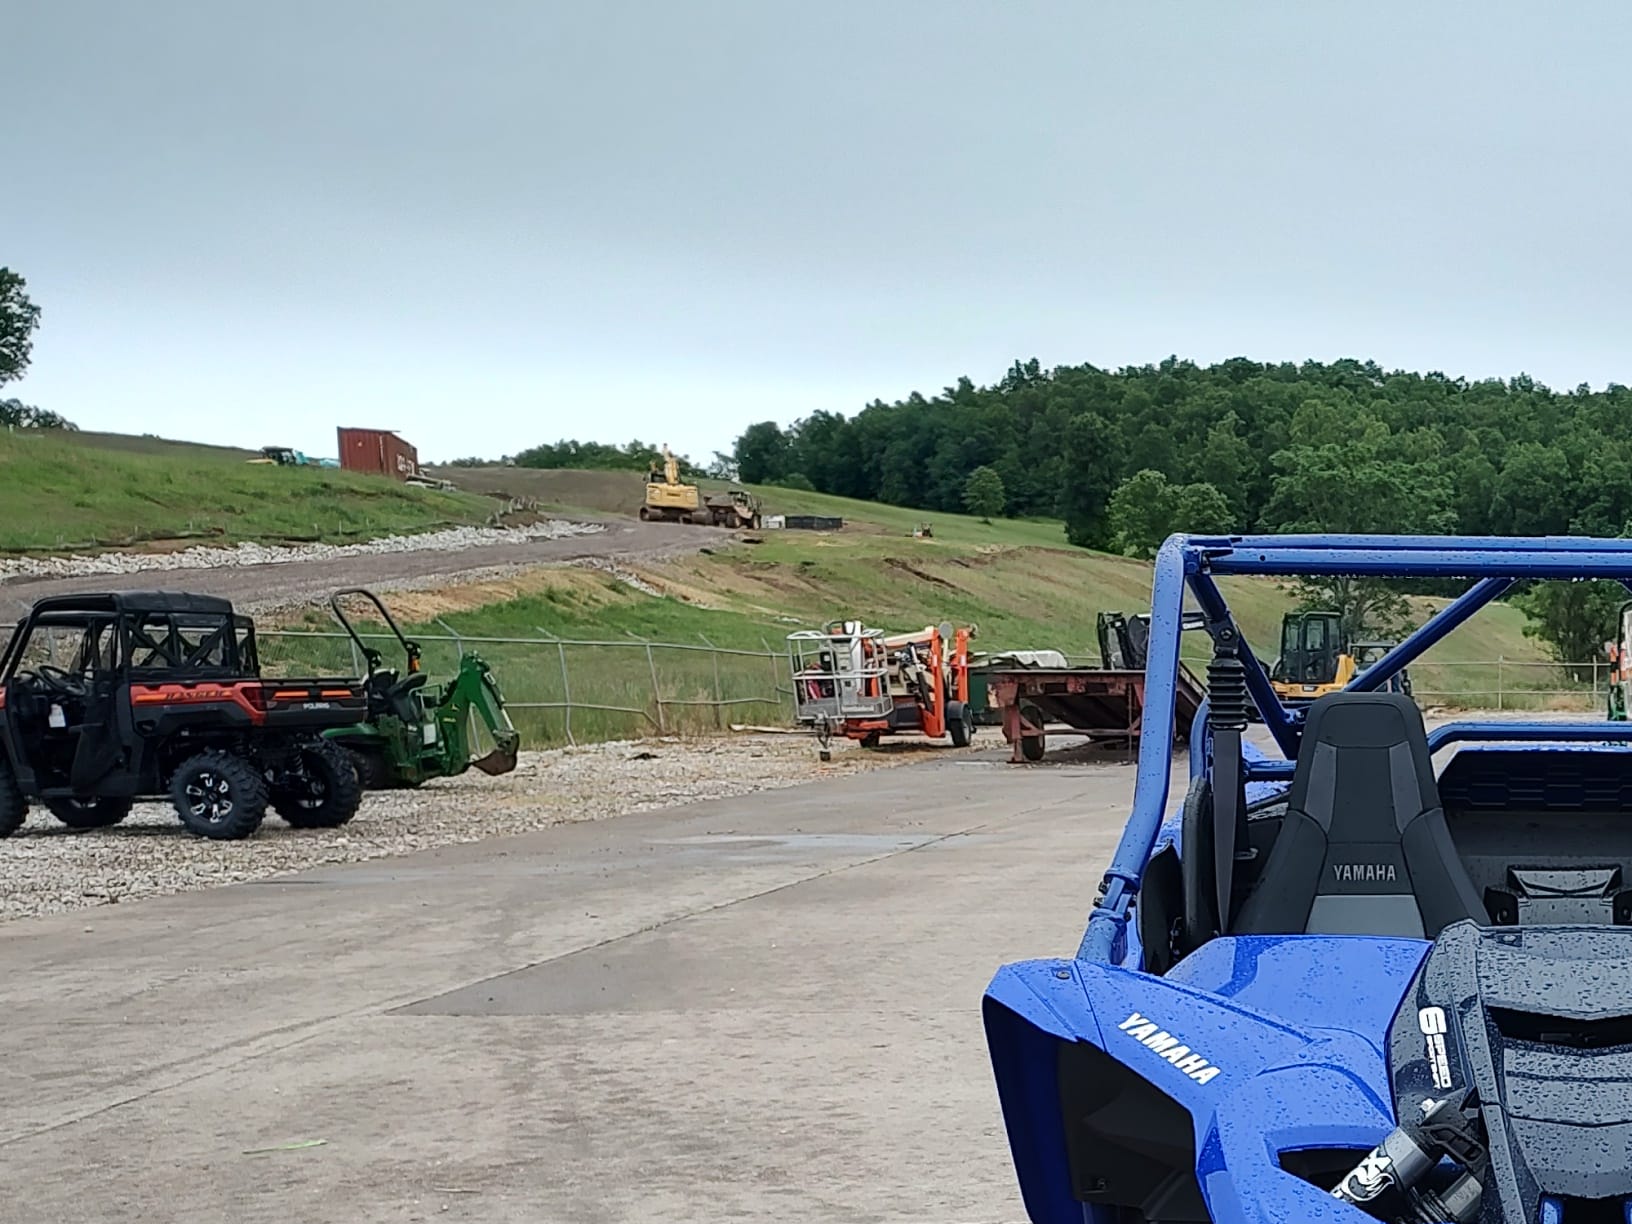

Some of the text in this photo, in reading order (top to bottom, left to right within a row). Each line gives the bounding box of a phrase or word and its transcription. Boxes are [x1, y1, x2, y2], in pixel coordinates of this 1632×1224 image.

[1333, 864, 1396, 881] YAMAHA
[1118, 1012, 1221, 1085] YAMAHA
[1418, 1006, 1452, 1088] 6 SPEED
